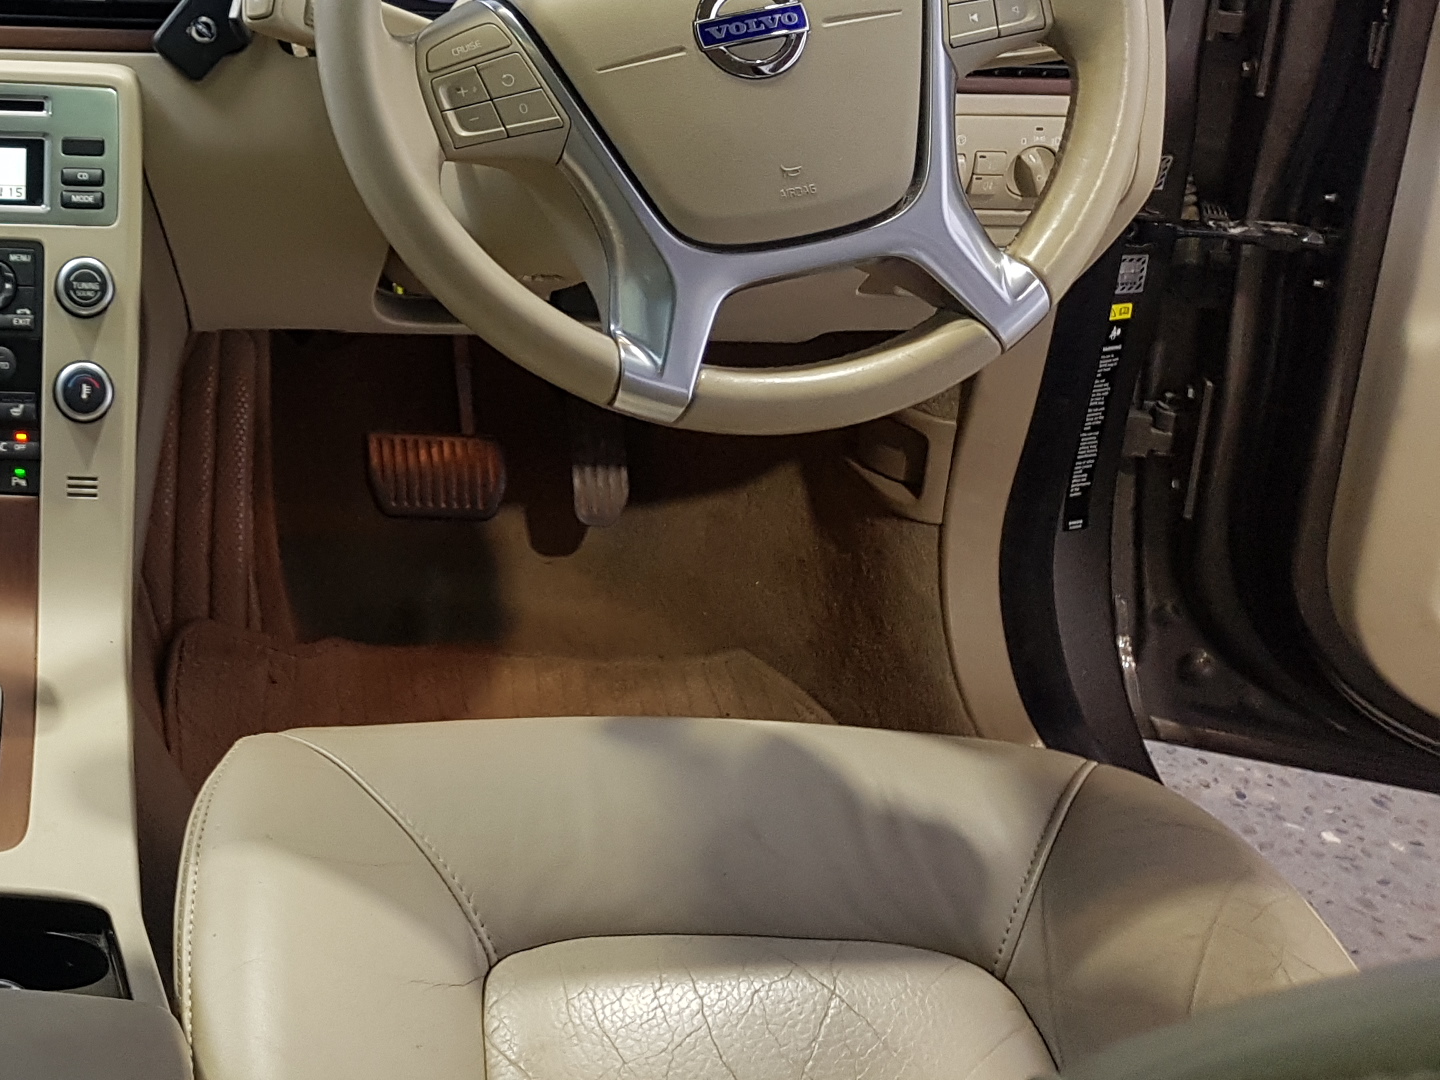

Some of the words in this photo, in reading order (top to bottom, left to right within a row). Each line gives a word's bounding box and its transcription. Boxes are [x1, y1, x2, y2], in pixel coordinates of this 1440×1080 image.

[705, 11, 799, 40] VOLVO
[451, 39, 482, 56] CRUISE
[9, 253, 32, 262] MENU
